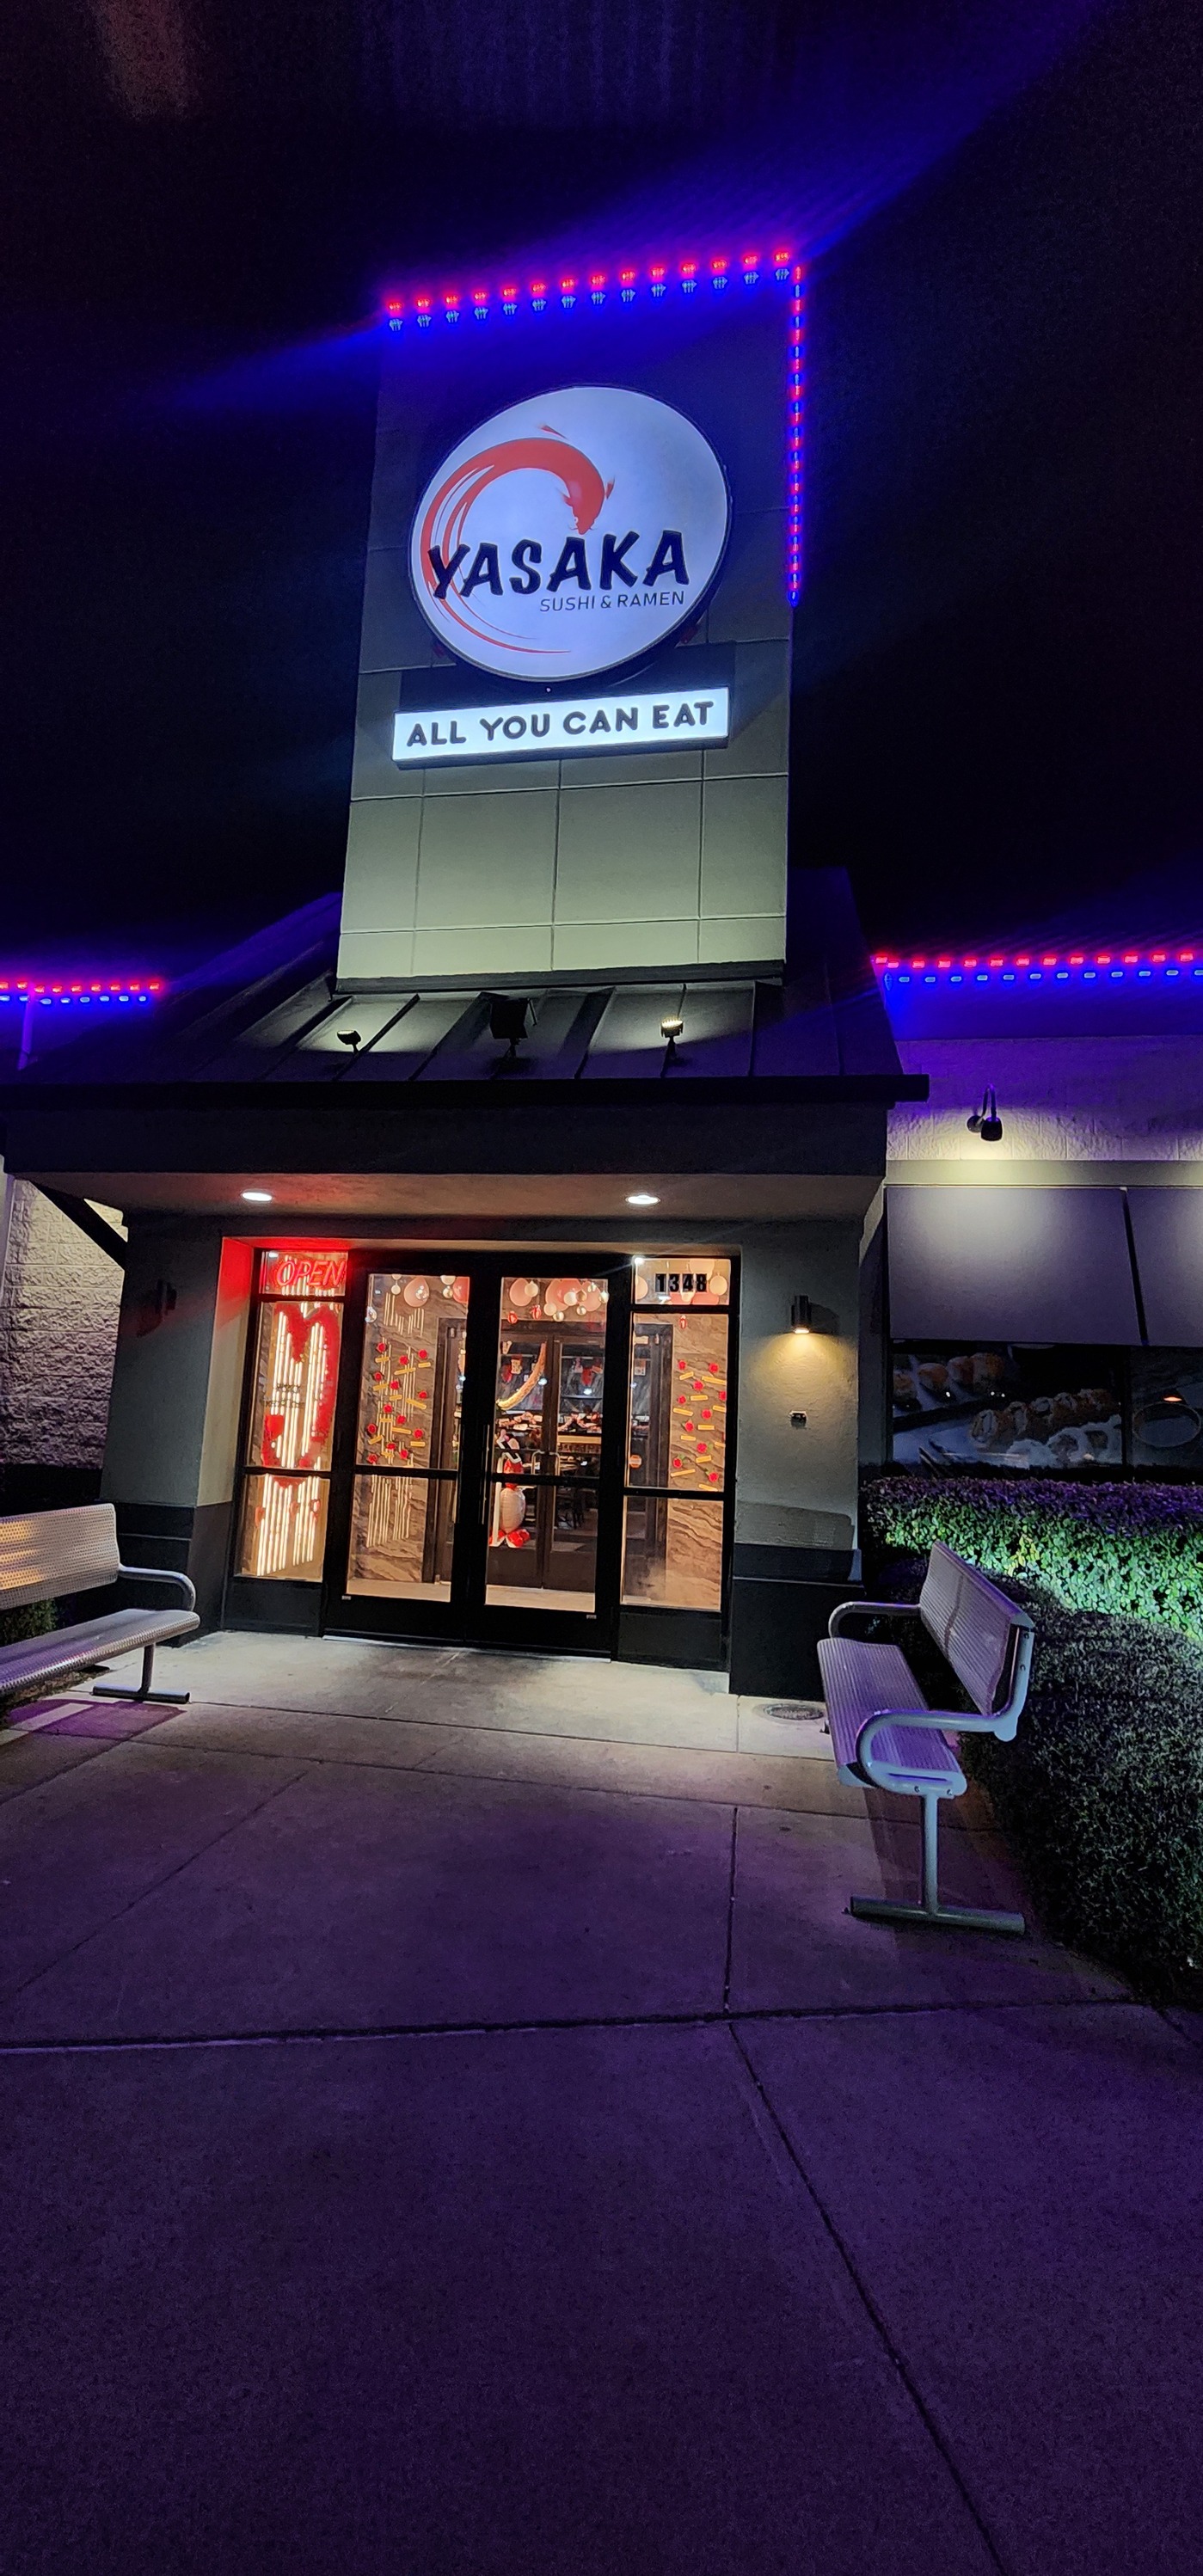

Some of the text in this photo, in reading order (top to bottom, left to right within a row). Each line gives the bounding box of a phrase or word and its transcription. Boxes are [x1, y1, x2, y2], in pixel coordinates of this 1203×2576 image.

[427, 530, 690, 599] YASAKA
[539, 591, 684, 612] SUSHI & RAMEN
[407, 701, 714, 747] ALL YOU CAN EAT
[276, 1260, 346, 1286] OPEN
[655, 1273, 708, 1292] 1348
